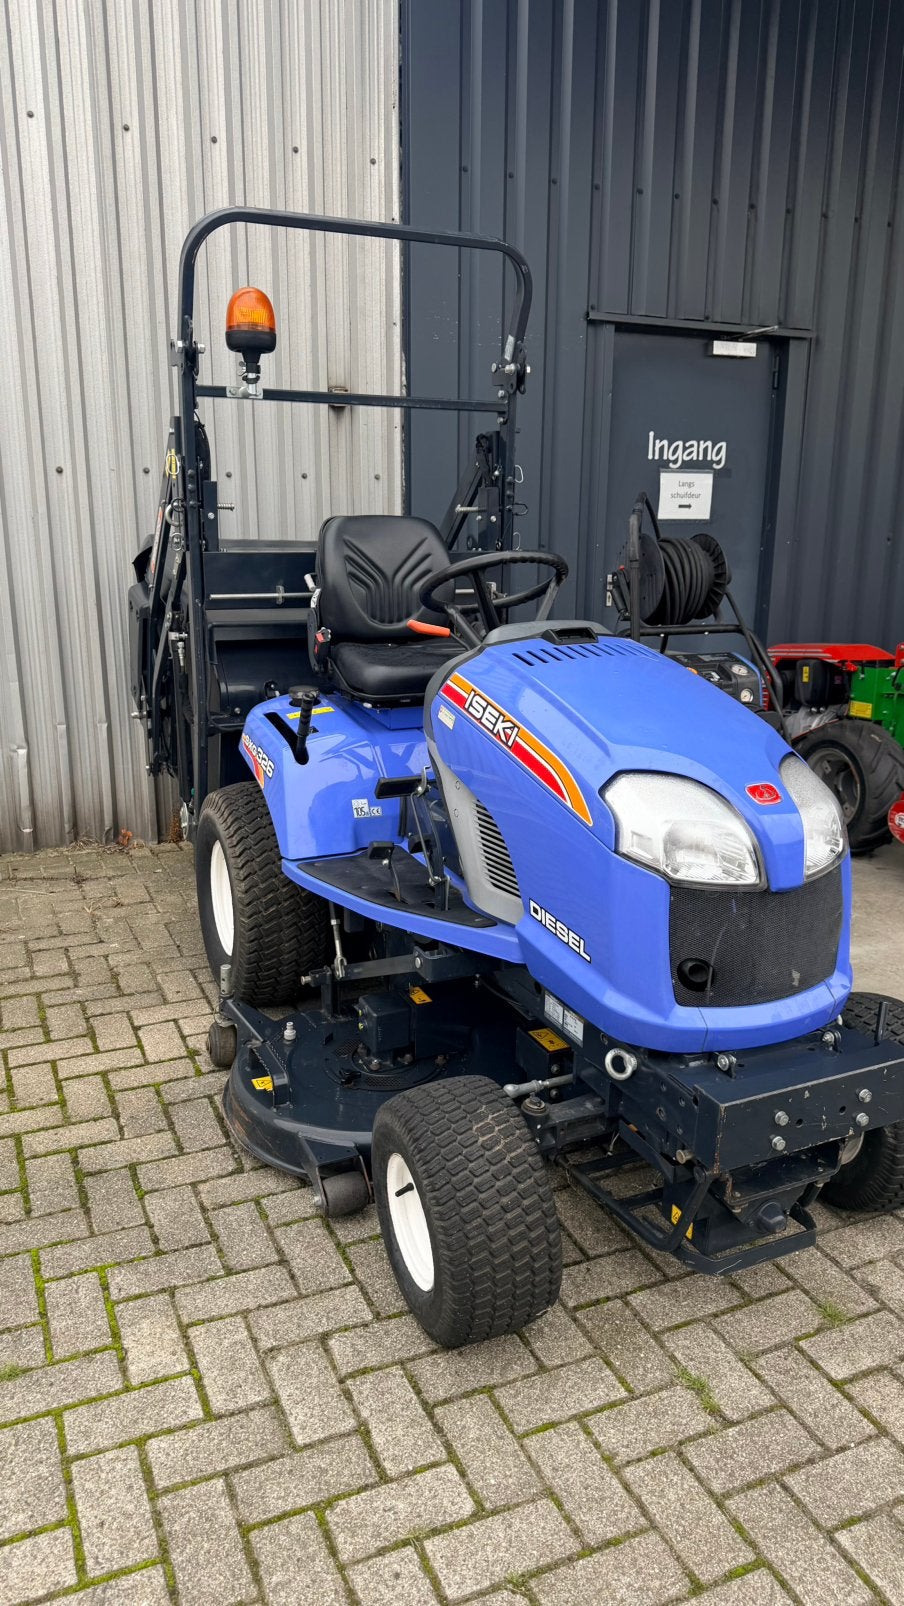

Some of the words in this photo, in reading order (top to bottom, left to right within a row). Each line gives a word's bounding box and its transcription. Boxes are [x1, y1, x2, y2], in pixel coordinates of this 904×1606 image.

[648, 430, 726, 469] Ingang
[670, 491, 701, 499] schuifdeur
[678, 480, 695, 488] Langs
[464, 689, 521, 749] ISEKI
[529, 897, 592, 964] DIESEL
